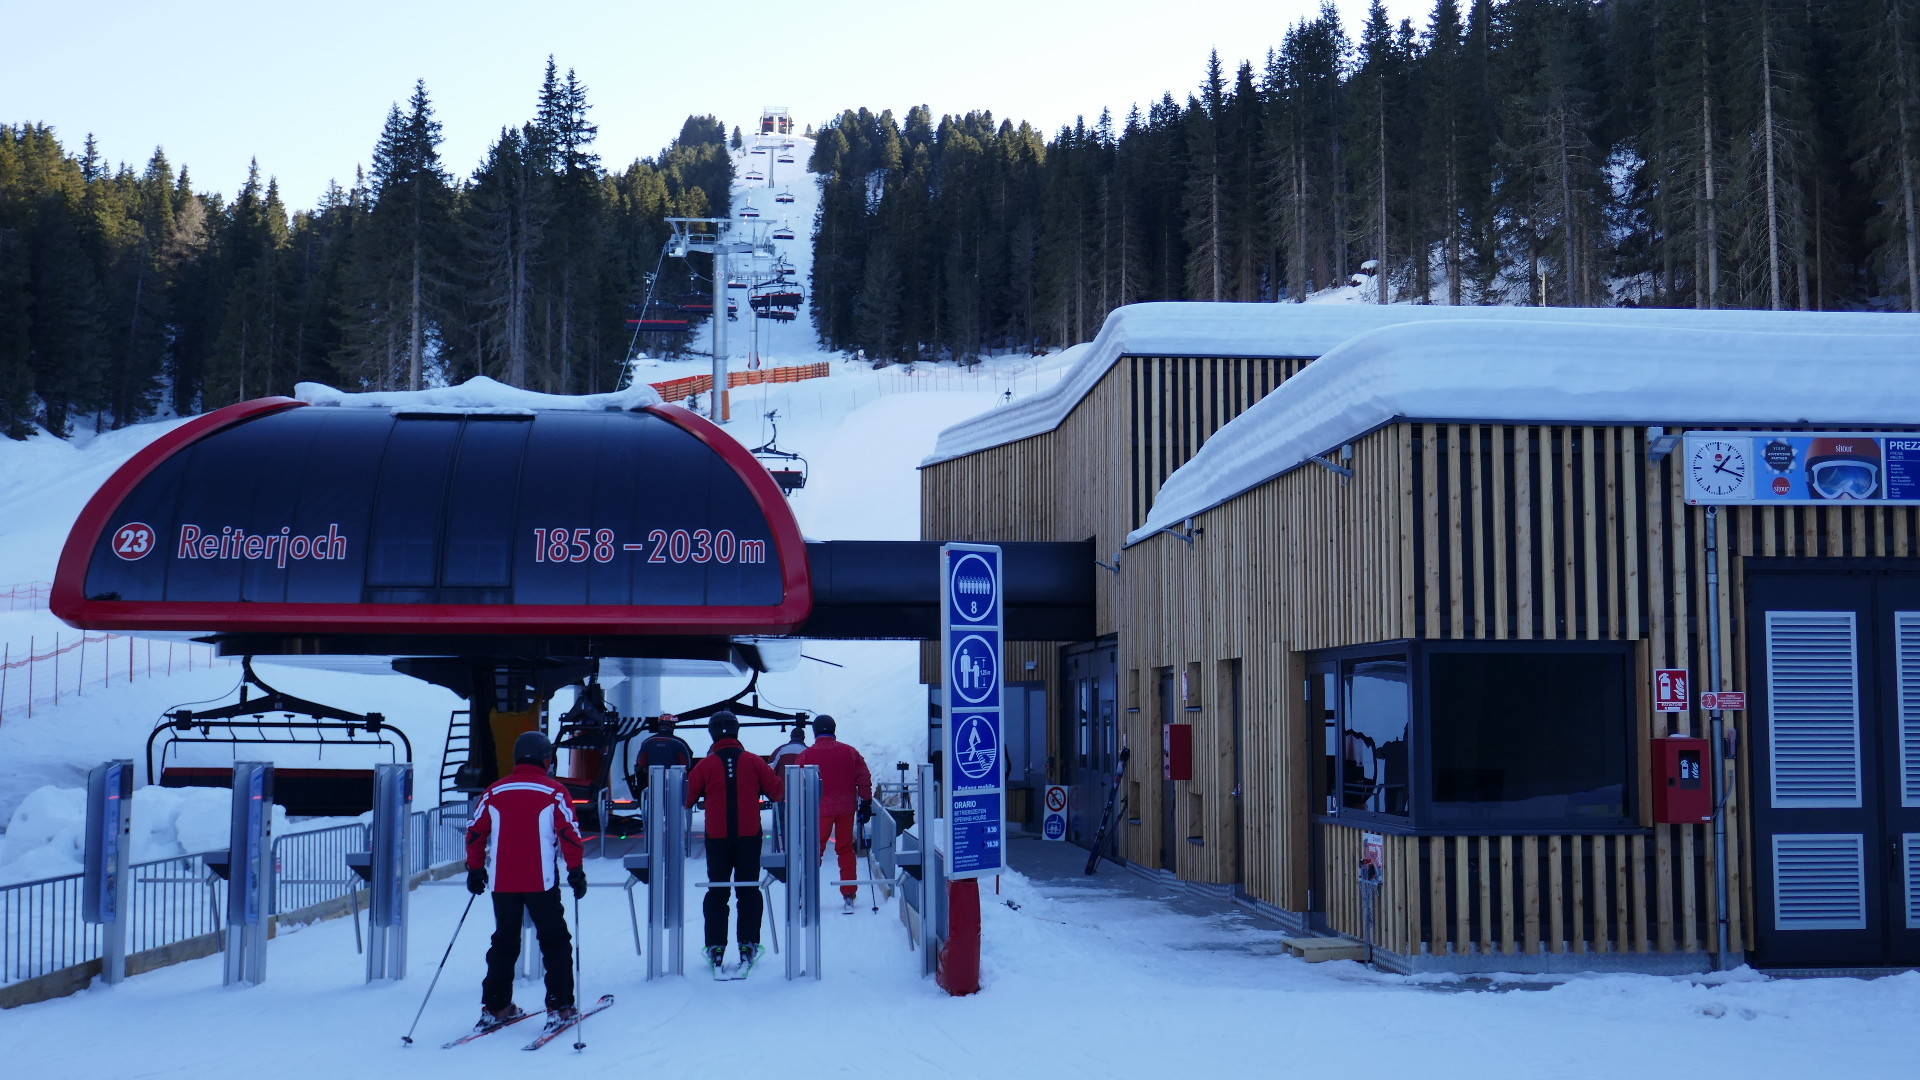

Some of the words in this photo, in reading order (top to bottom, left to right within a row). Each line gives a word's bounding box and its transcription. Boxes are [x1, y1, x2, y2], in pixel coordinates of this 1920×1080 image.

[118, 529, 149, 553] 23
[177, 523, 347, 569] Reiterjoch
[970, 601, 978, 614] 8
[954, 801, 976, 809] ORARIO
